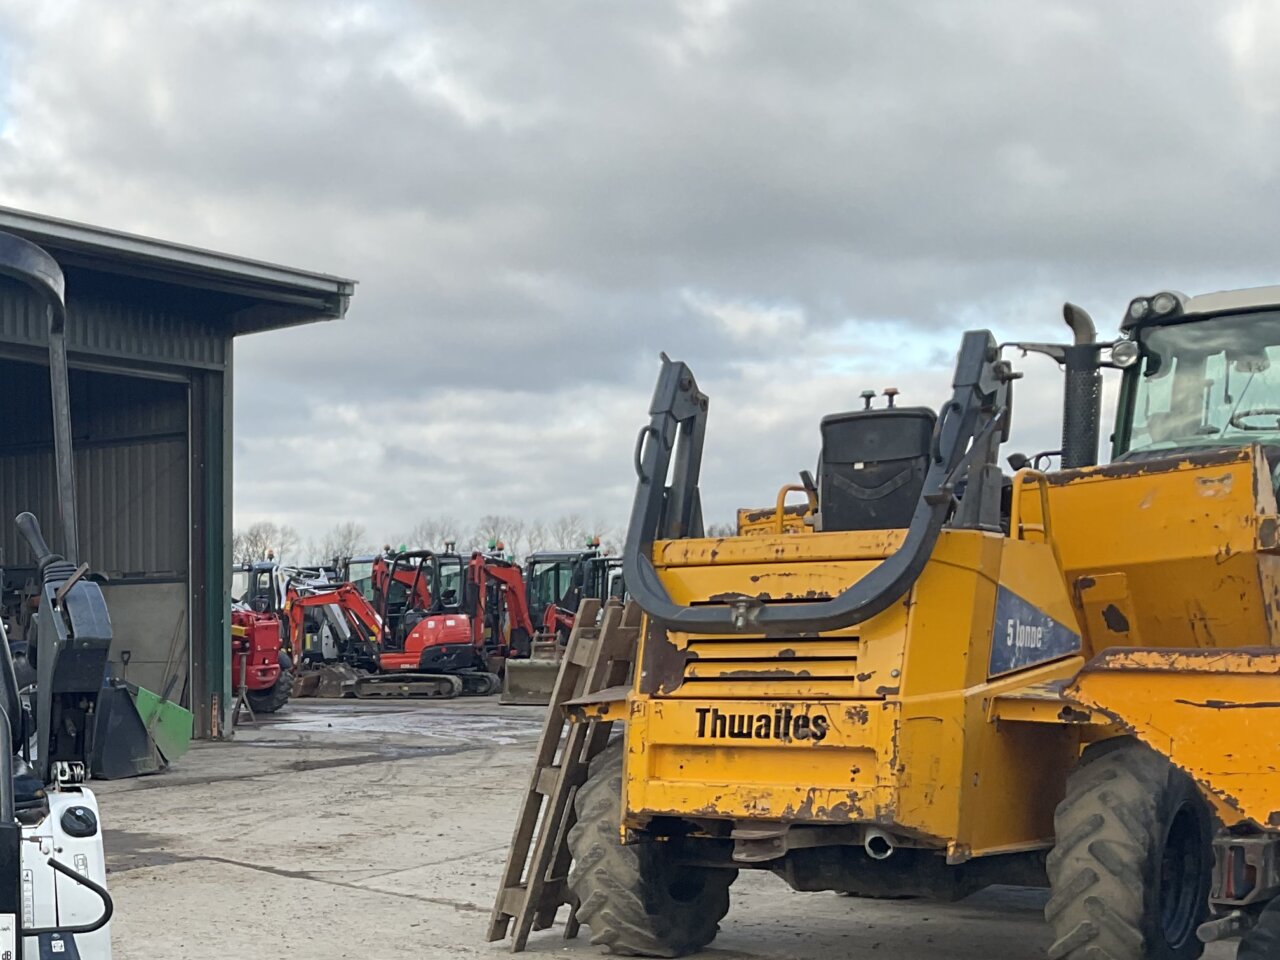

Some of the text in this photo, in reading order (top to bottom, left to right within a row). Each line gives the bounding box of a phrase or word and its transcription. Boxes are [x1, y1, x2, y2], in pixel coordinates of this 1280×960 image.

[1007, 618, 1014, 647] 5
[695, 708, 827, 740] Thwaites
[2, 950, 12, 960] dB
